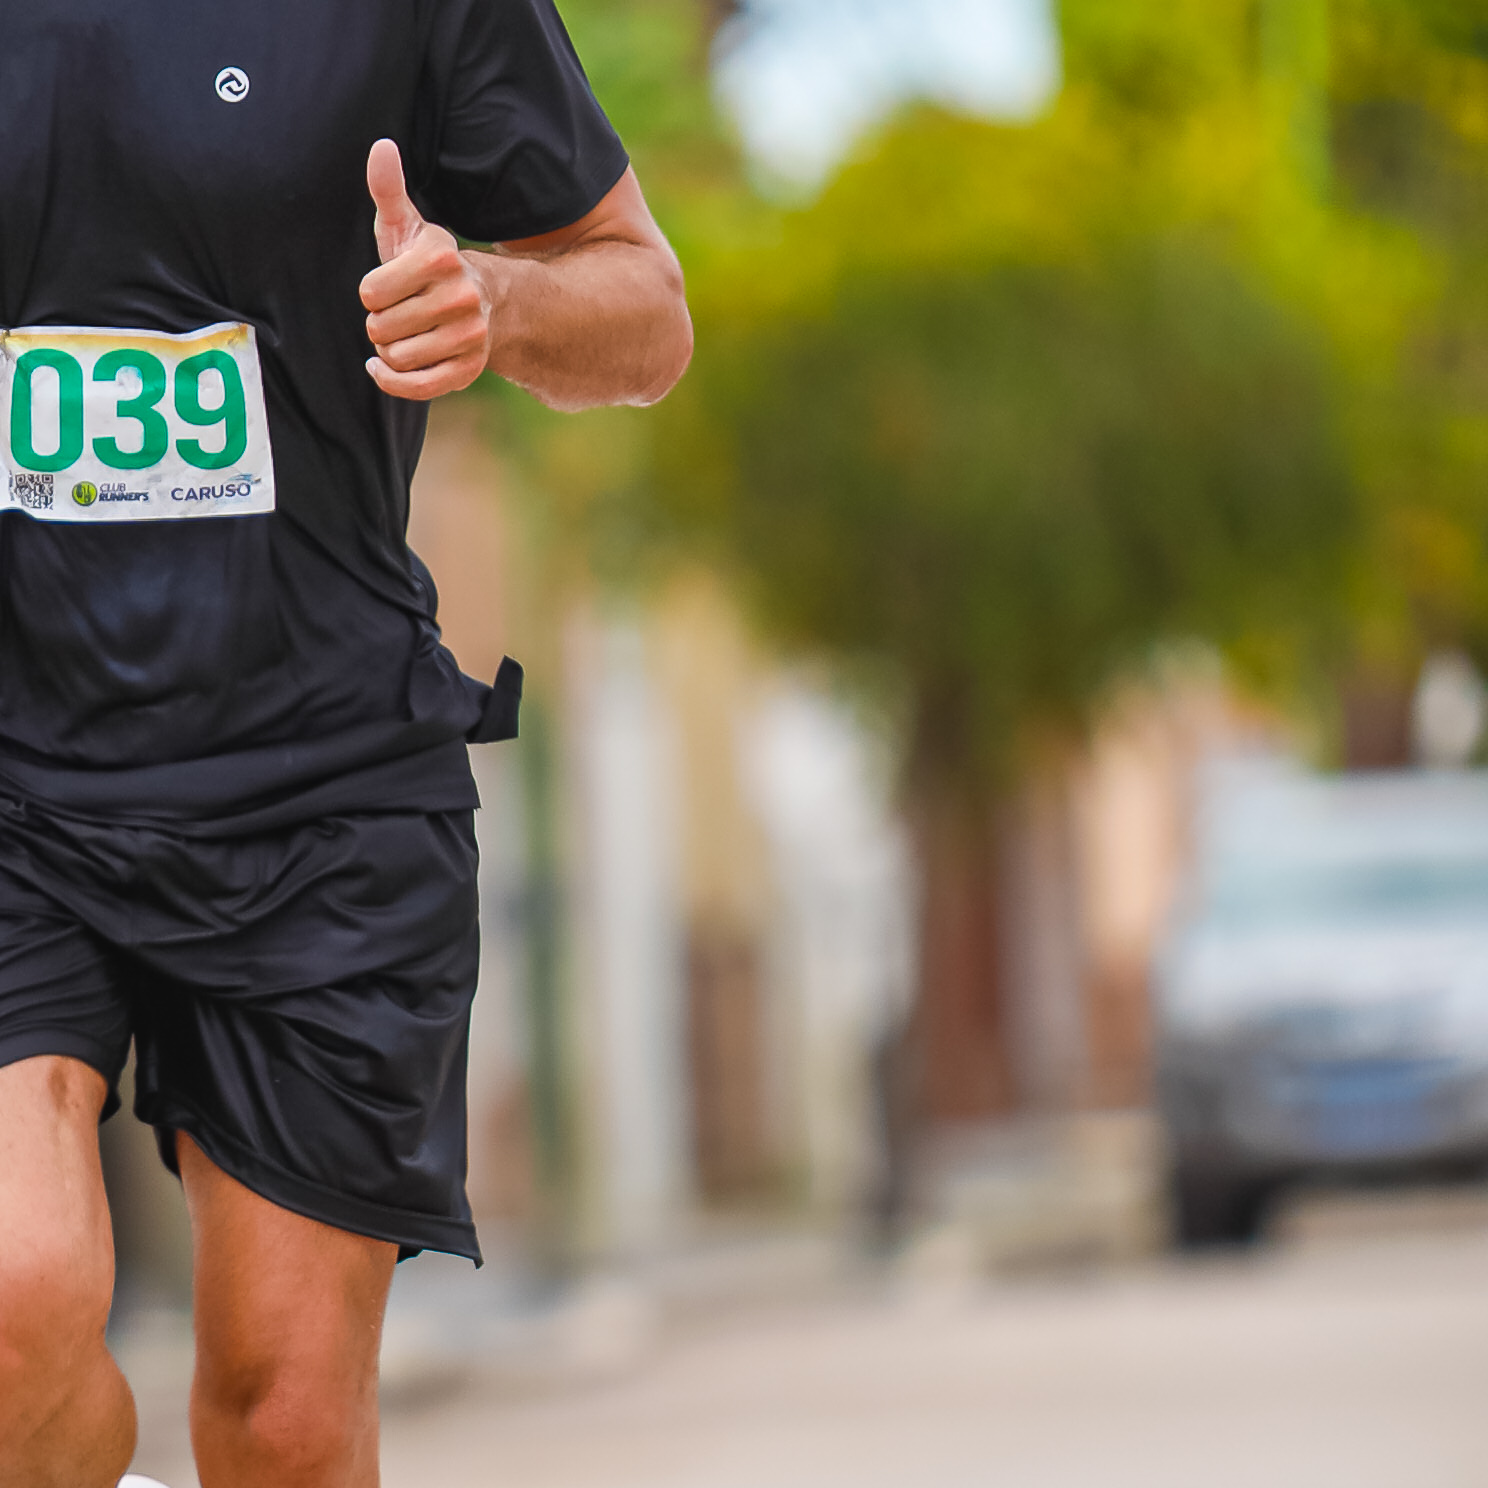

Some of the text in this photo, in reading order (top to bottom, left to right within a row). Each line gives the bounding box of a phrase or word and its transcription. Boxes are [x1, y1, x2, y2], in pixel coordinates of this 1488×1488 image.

[10, 348, 248, 472] 039
[99, 482, 127, 492] CLUB
[171, 482, 251, 501] CARUSO
